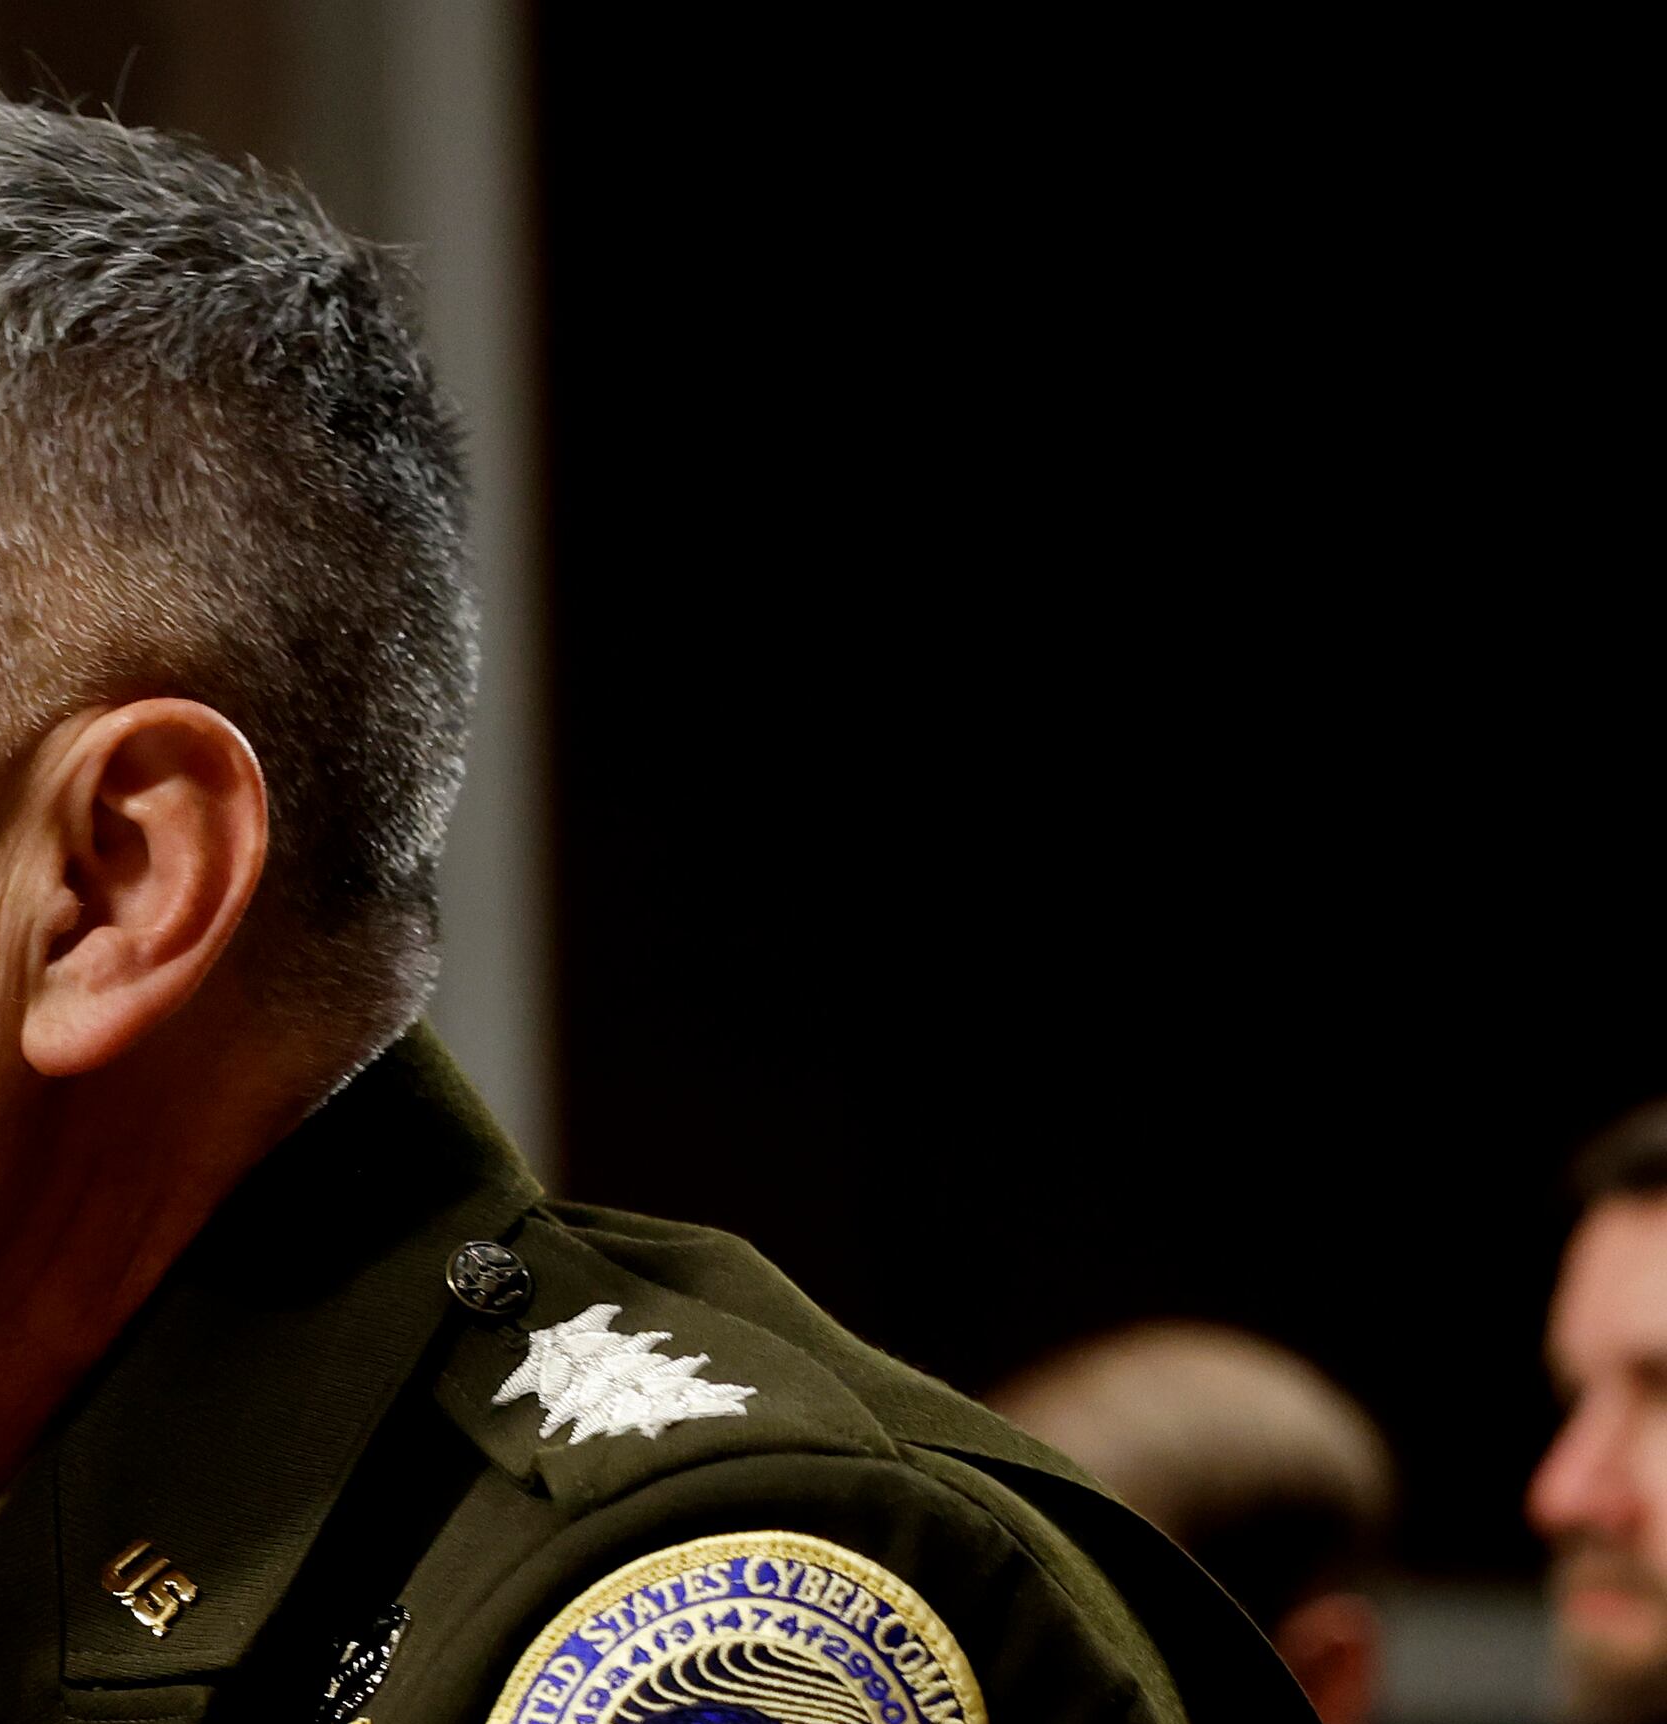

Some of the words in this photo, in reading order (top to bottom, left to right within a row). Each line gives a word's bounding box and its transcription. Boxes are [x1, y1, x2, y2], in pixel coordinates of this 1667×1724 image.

[101, 1541, 199, 1637] US
[579, 1562, 732, 1653] STATES
[743, 1556, 882, 1631] CYBER
